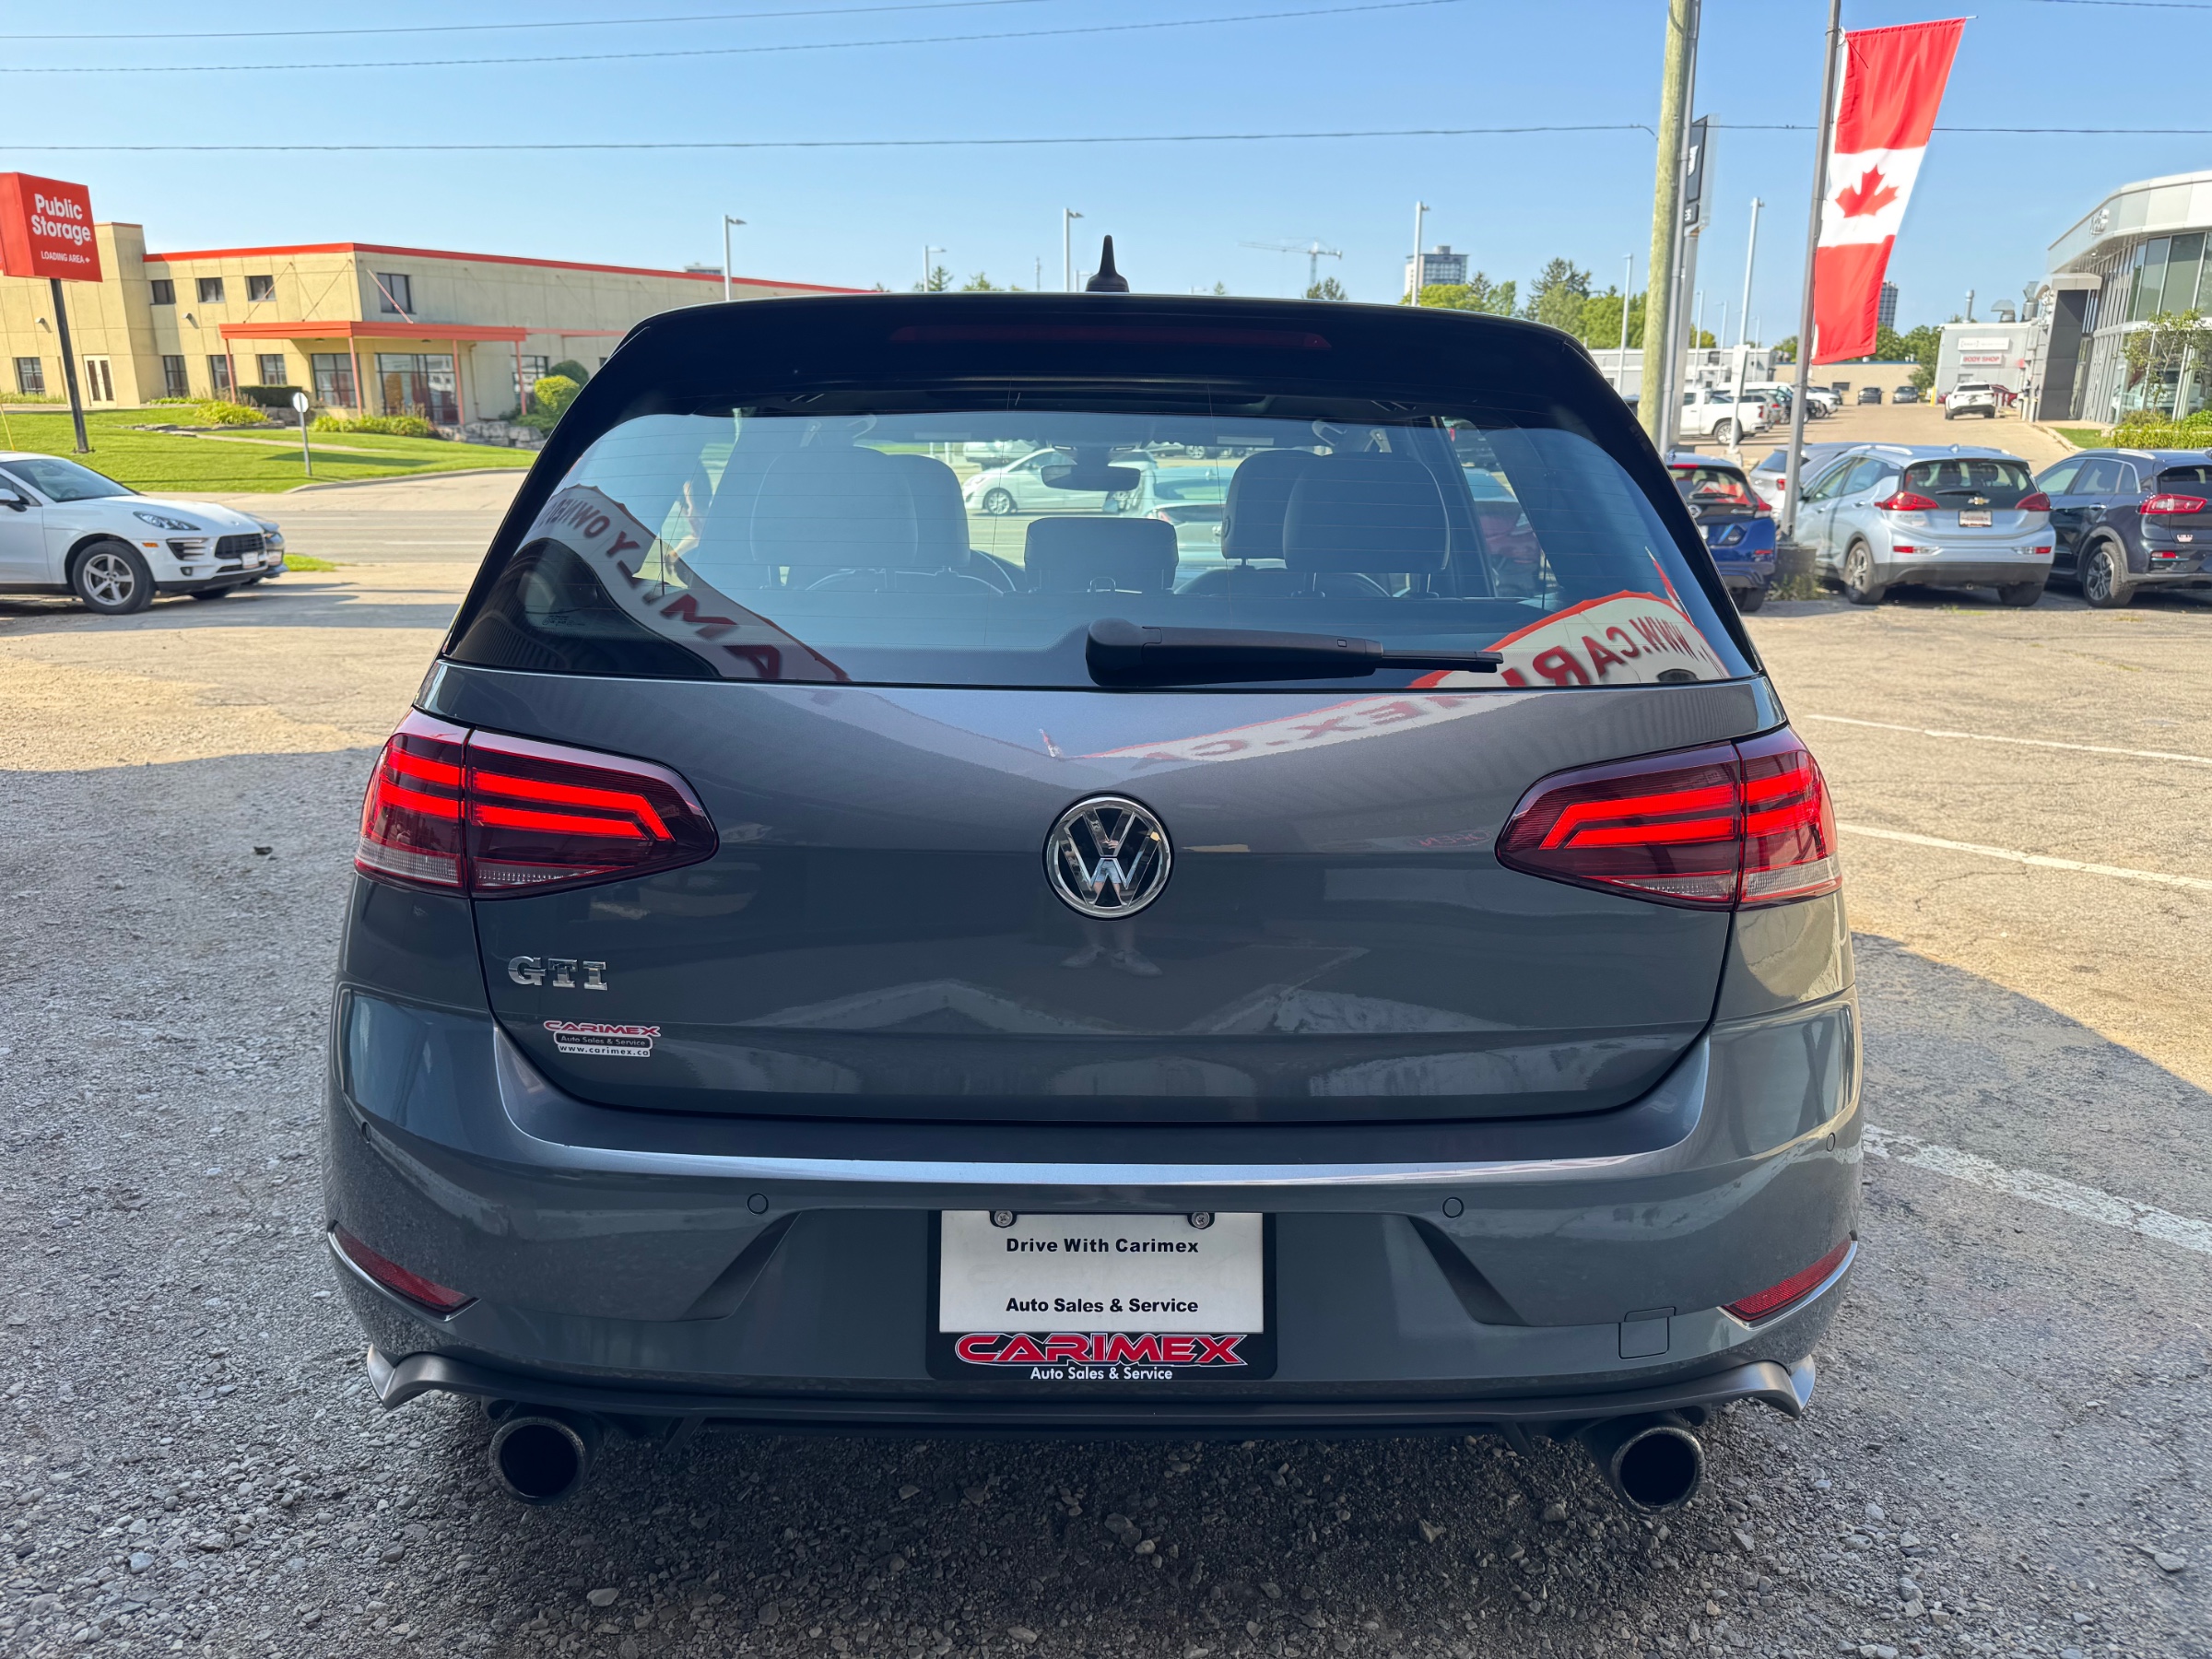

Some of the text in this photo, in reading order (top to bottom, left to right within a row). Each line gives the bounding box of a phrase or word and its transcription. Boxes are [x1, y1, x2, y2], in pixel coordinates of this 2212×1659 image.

[34, 193, 83, 220] Public
[30, 214, 91, 246] Storage
[41, 250, 85, 264] LOADING AREA
[508, 955, 608, 991] GTI
[544, 1020, 661, 1037] CARIMEX
[560, 1035, 581, 1043] Auto
[616, 1039, 646, 1047] Service
[1006, 1238, 1199, 1253] Drive With Carimex
[1006, 1298, 1199, 1312] Auto Sales & Service
[955, 1333, 1248, 1366] CARIMEX
[1030, 1367, 1173, 1380] Auto Sales & Service
